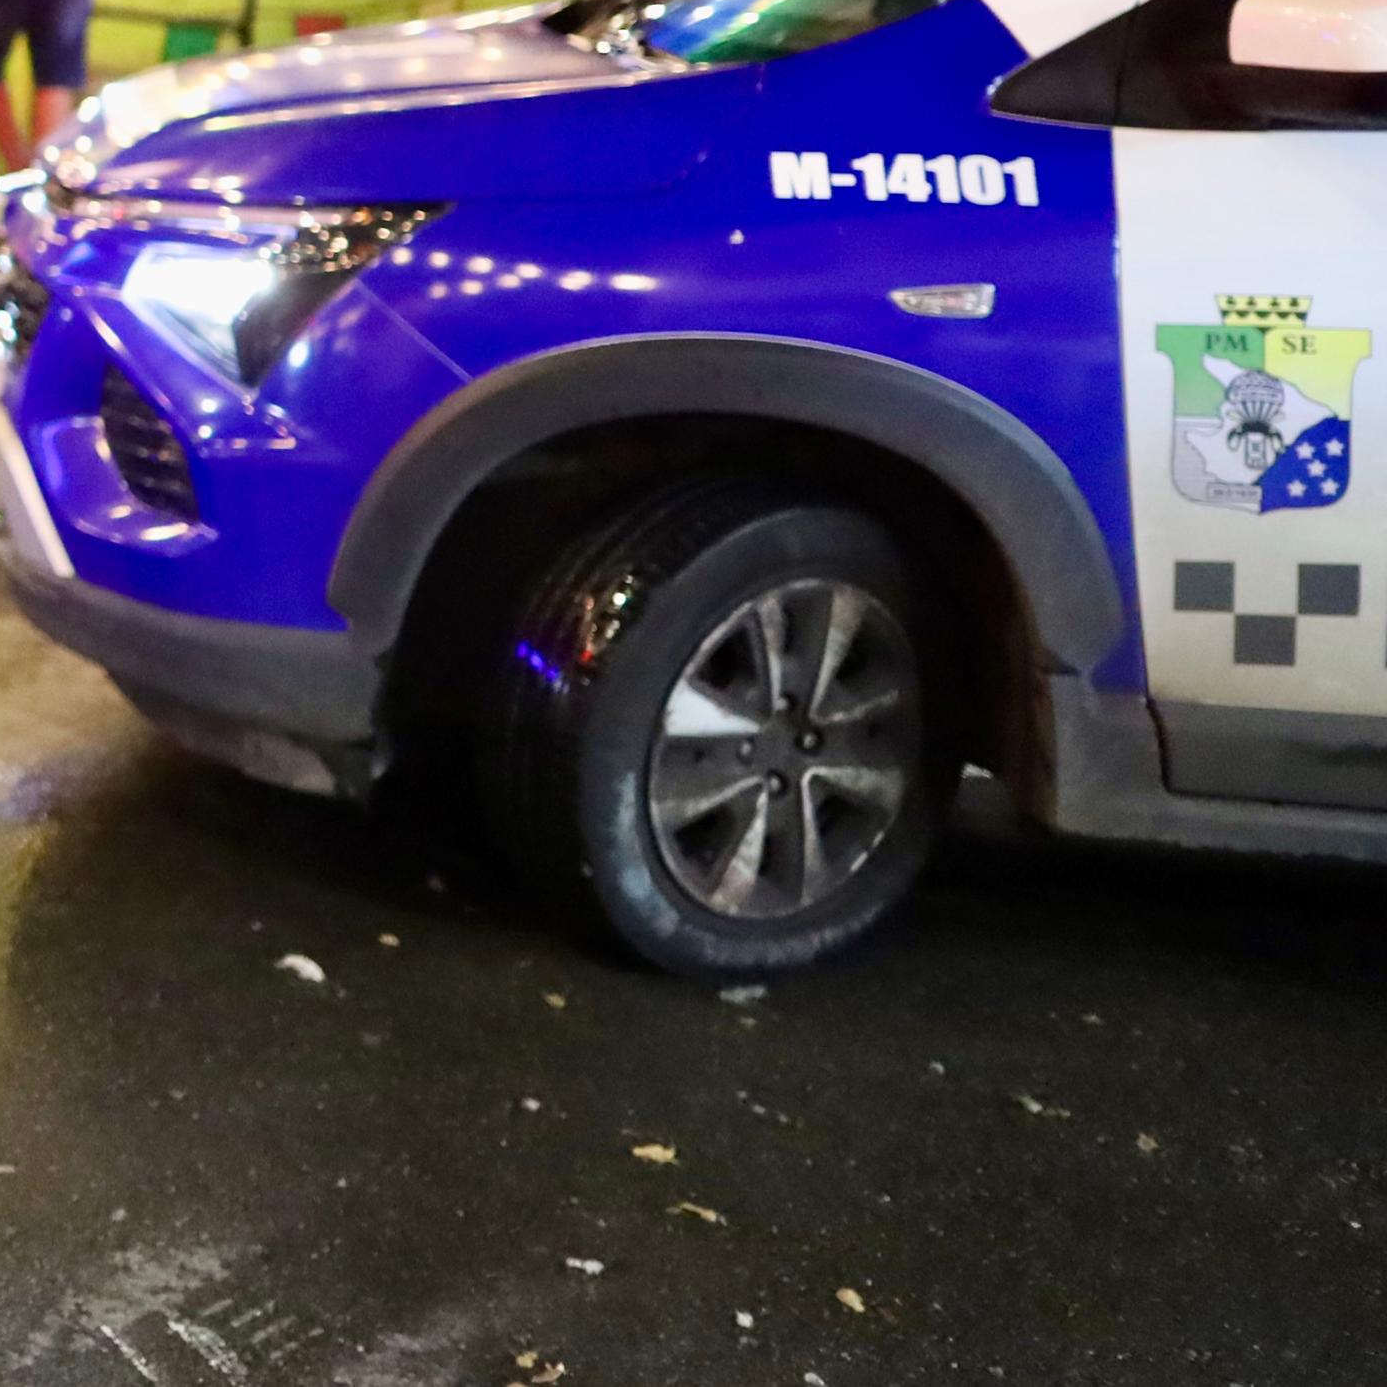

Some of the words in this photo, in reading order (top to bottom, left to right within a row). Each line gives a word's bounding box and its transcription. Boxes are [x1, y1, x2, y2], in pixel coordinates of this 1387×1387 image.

[769, 151, 1040, 207] M-14101
[1204, 331, 1249, 353] PM
[1282, 334, 1317, 355] SE
